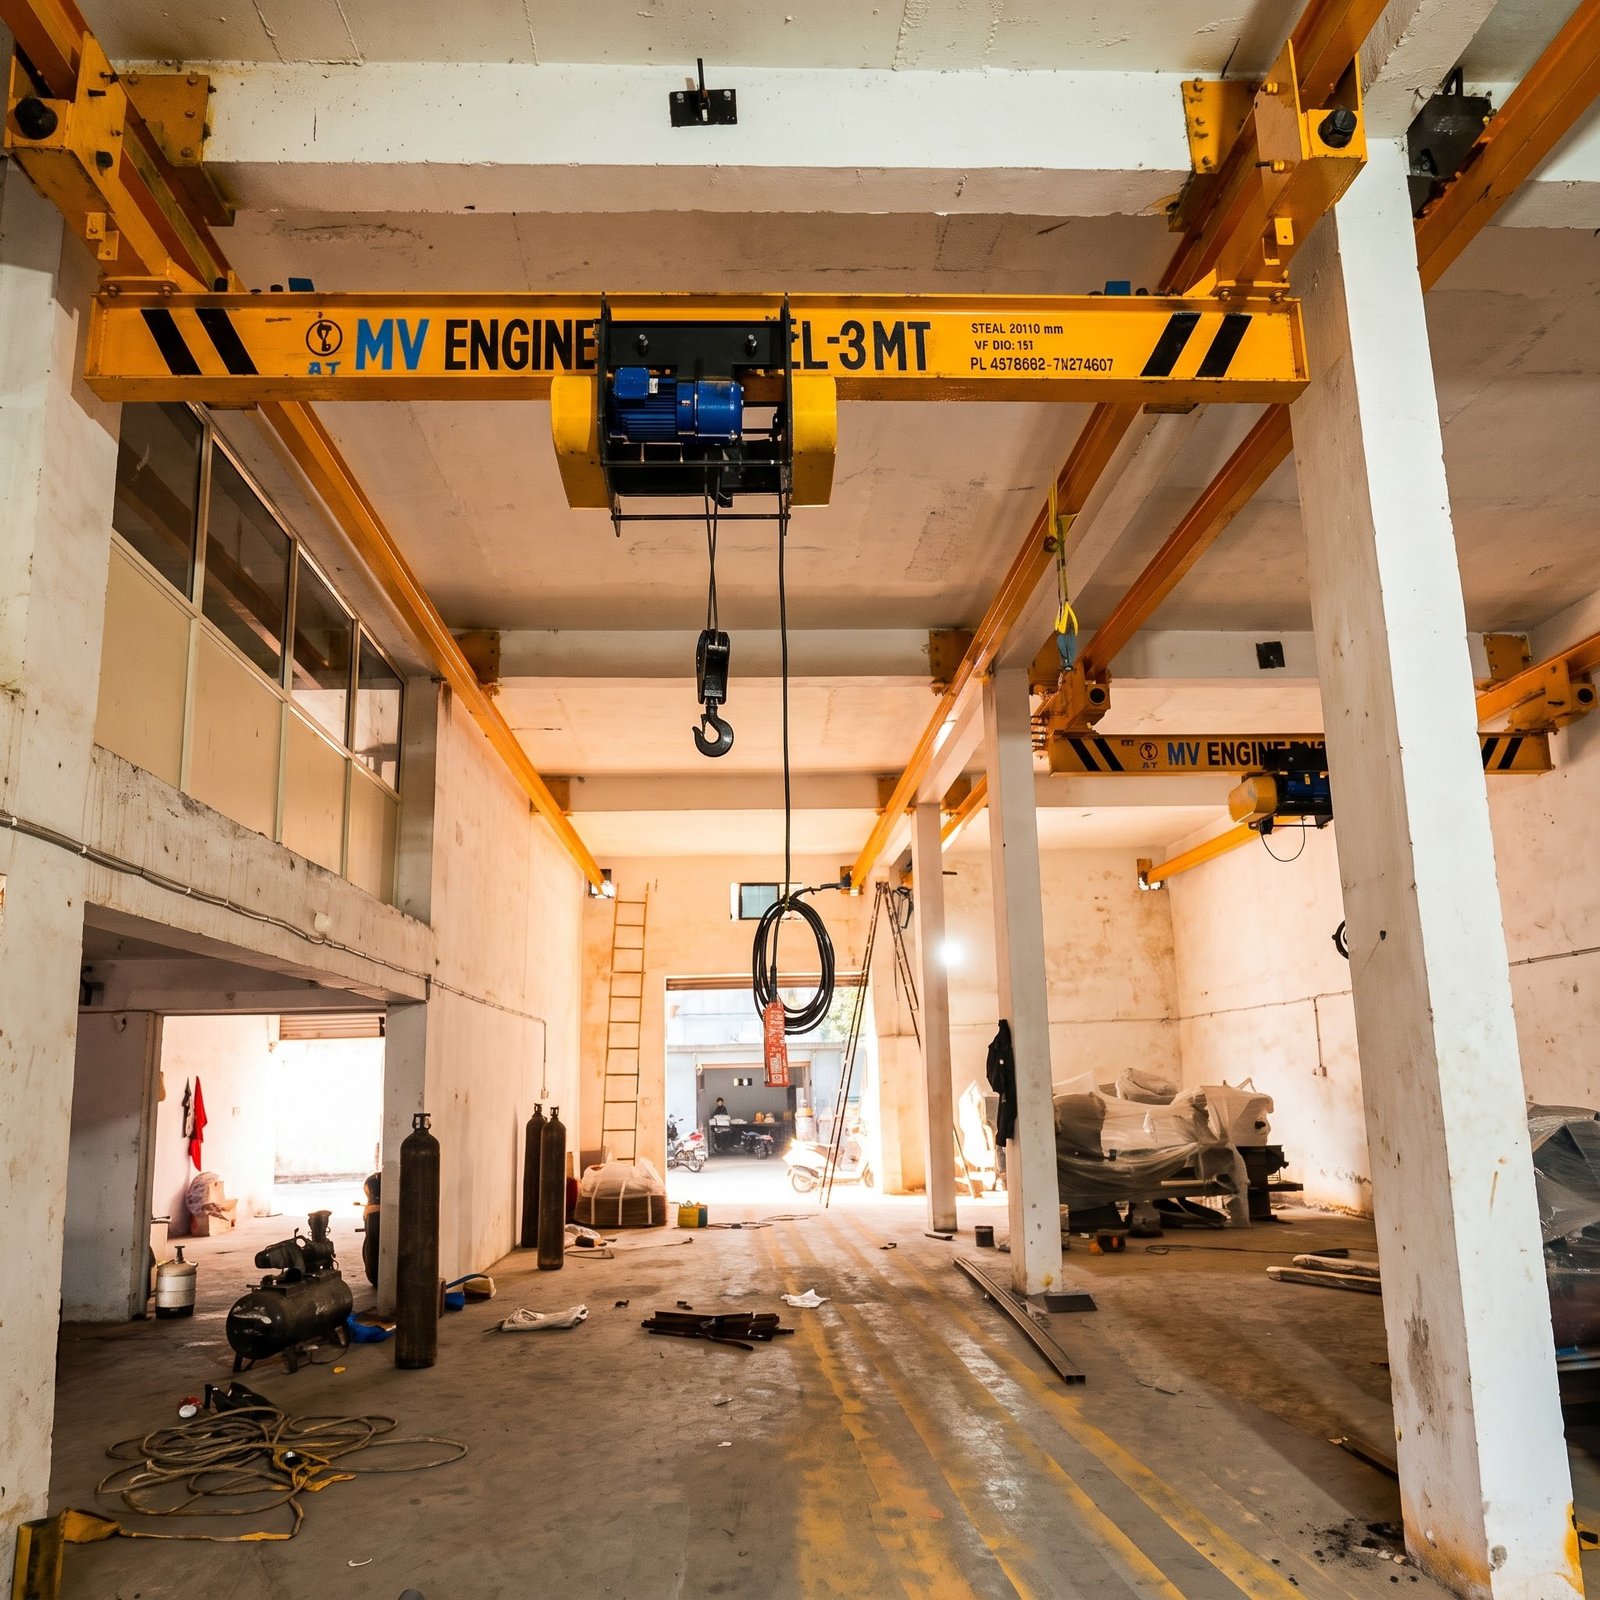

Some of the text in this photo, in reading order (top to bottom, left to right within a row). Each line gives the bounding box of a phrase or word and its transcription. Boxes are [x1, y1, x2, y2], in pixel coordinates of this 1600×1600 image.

[971, 323, 1064, 334] STEAL 20110 mm
[355, 319, 430, 370] MV
[444, 319, 596, 371] ENGINE
[974, 340, 989, 350] VF
[970, 357, 987, 371] PL
[1167, 742, 1200, 766] MV
